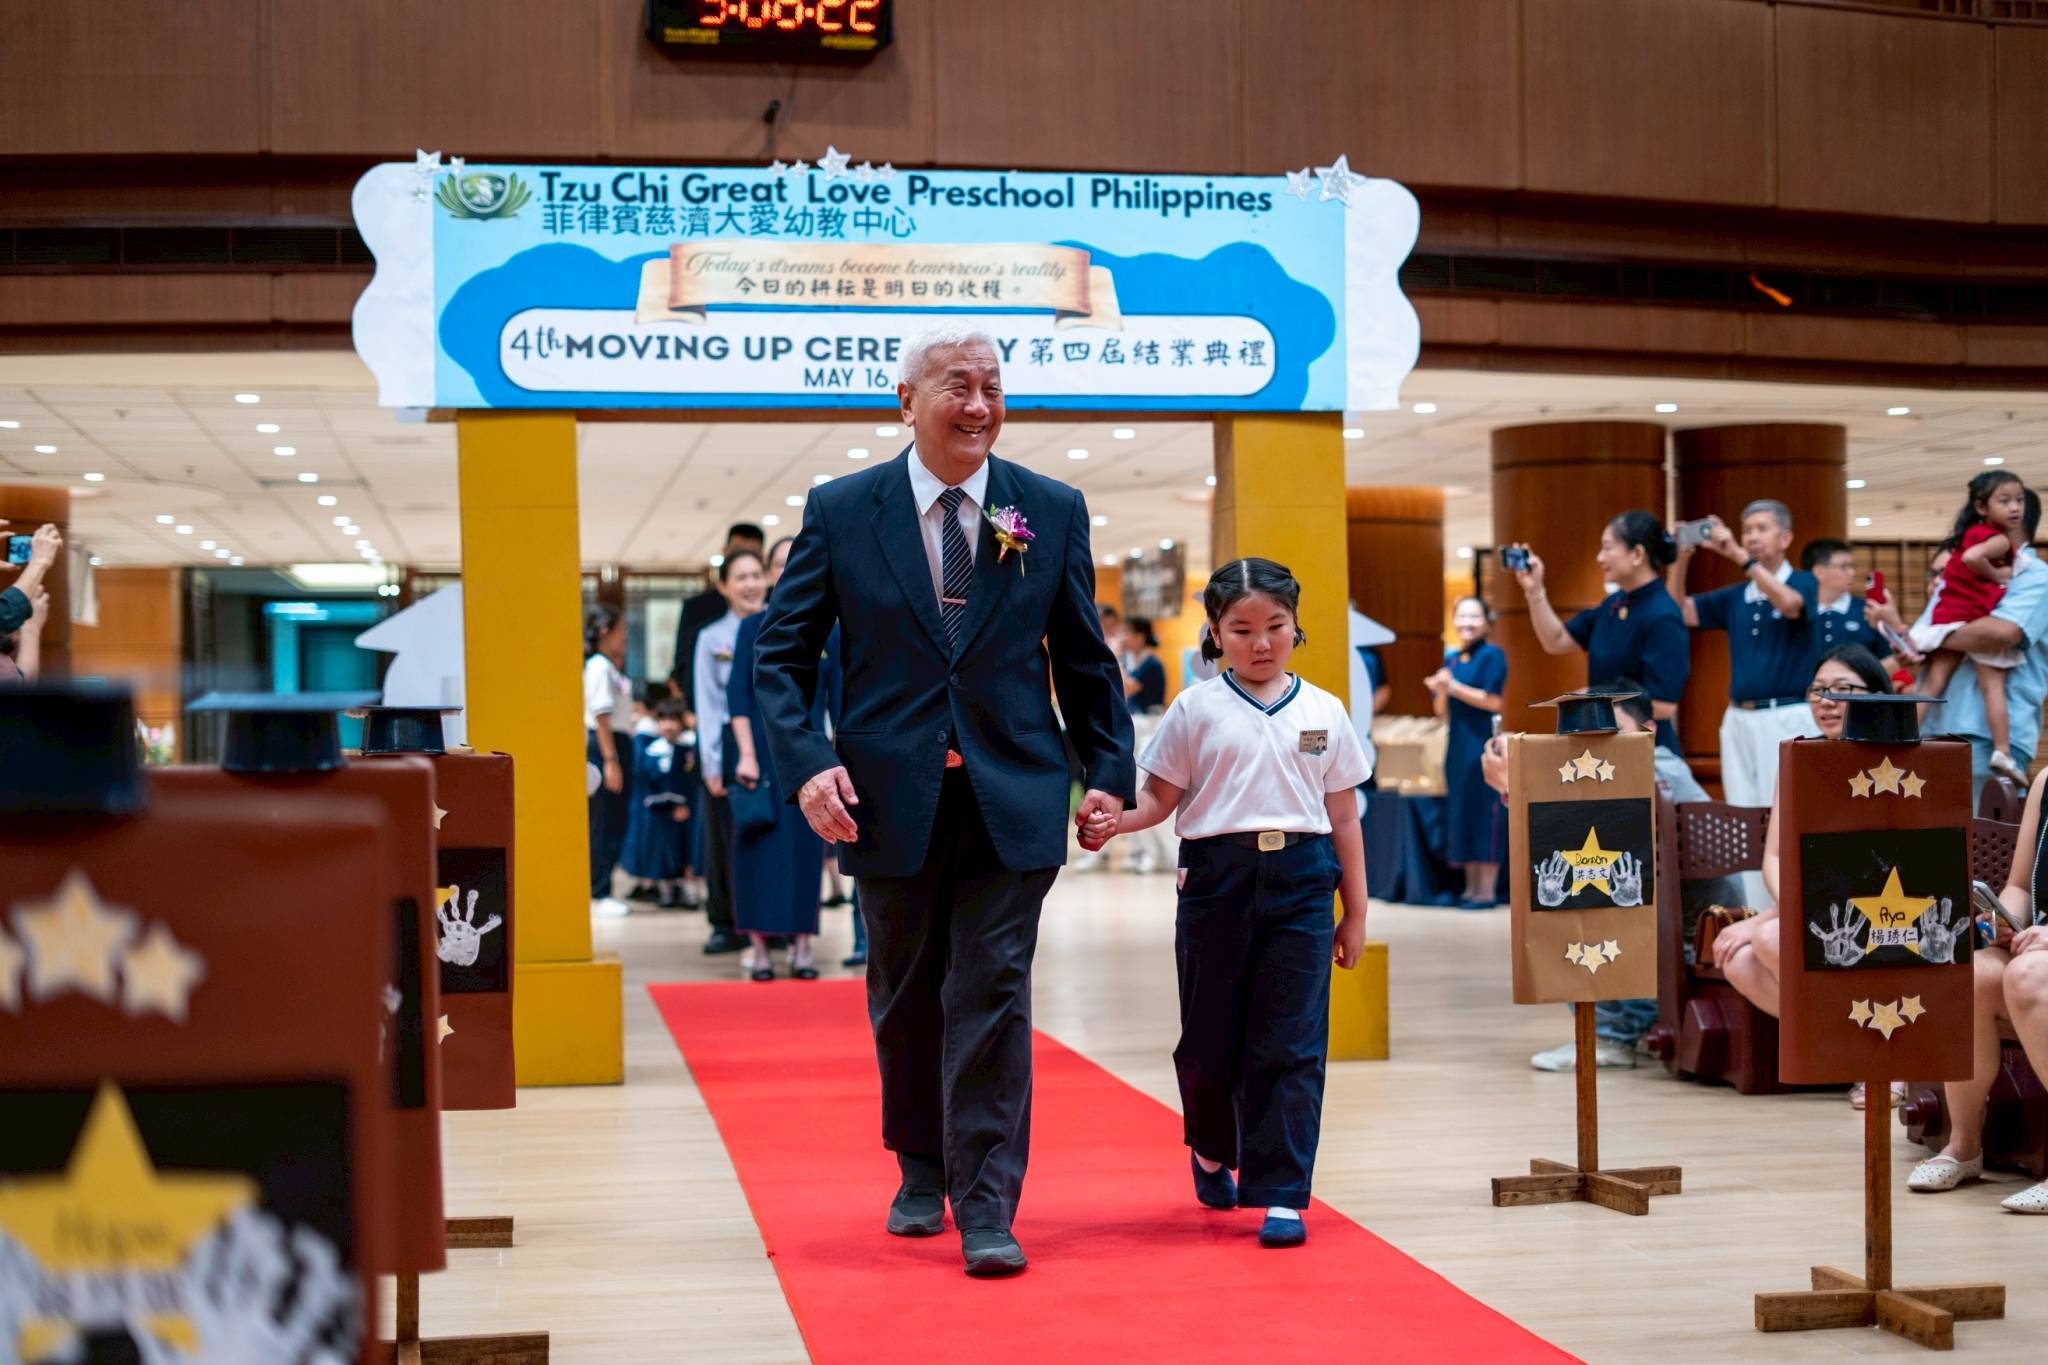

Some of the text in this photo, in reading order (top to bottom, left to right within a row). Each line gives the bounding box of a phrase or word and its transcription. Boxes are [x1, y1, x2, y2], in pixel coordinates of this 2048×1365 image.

[539, 171, 1273, 218] Tzu Chi Great Love Preschool Philippines
[543, 203, 917, 239] 菲律賓慈濟大愛幼教中心
[685, 252, 765, 276] Today's
[769, 257, 834, 274] dreams
[839, 258, 900, 275] become
[905, 260, 1007, 276] tomorrow's
[565, 334, 731, 361] MOVING
[744, 336, 793, 361] UP
[805, 336, 1018, 363] CEREY
[1029, 337, 1267, 368] 第四屆結業典禮
[804, 368, 896, 390] MAY 16,
